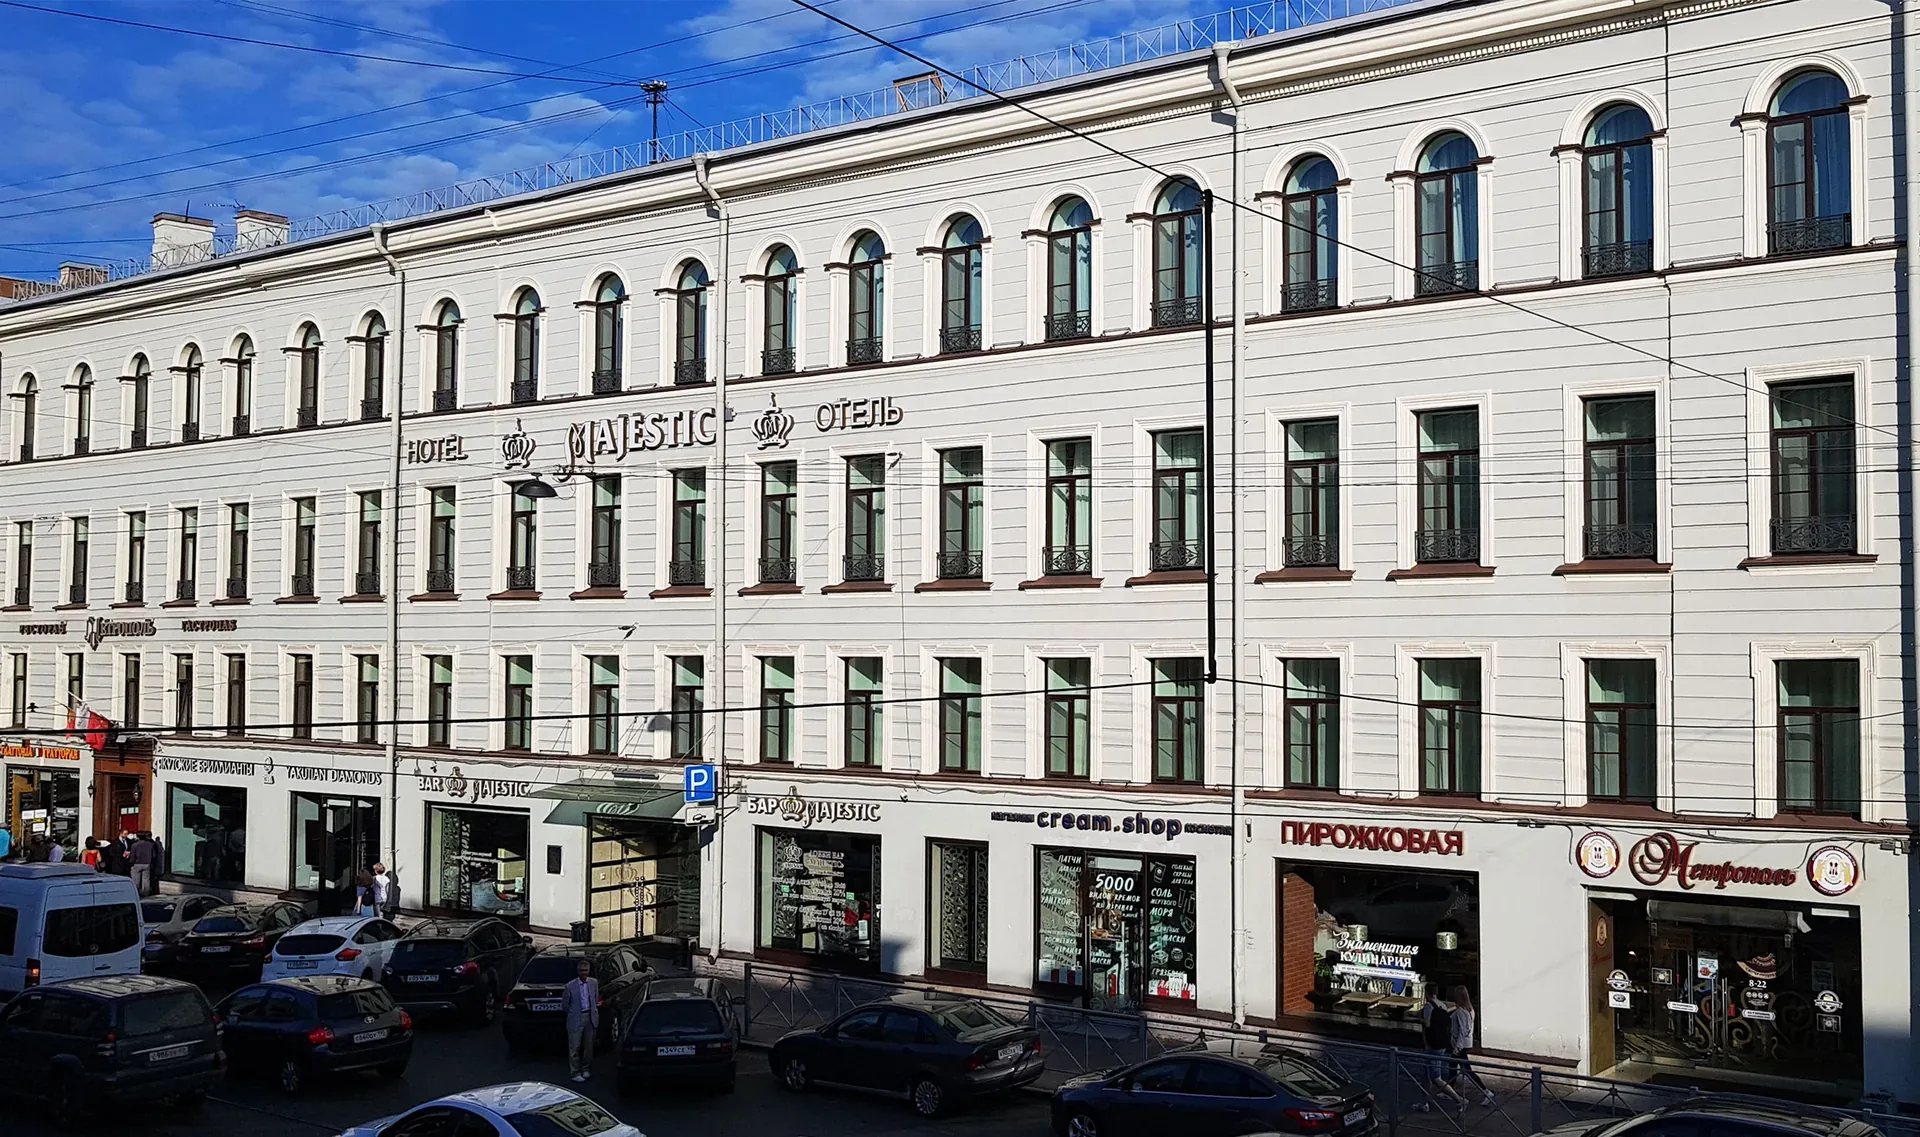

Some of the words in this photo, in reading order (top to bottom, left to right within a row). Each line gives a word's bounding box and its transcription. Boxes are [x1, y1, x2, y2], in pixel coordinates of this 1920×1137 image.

[815, 396, 904, 432] ОТЕЛЬ
[407, 435, 468, 464] HOTEL
[556, 407, 717, 482] MAJESTIC
[158, 757, 198, 773] ЯКУТСКИЕ
[199, 760, 255, 776] БРИЛЛИАНТЫ
[331, 768, 383, 785] DIAMONDS
[691, 769, 708, 798] P
[418, 776, 444, 792] BAR
[470, 779, 530, 803] MAJESTIC
[747, 796, 779, 814] БАР
[801, 801, 881, 828] MAJESTIC
[1036, 812, 1183, 841] cream.shop
[1281, 820, 1465, 855] ПИРОЖКОВАЯ
[1058, 854, 1081, 864] ПАТЧИ
[1628, 832, 1796, 890] Метрополь
[1095, 873, 1134, 892] 5000
[1114, 893, 1141, 903] КРЕМОВ
[1151, 888, 1173, 898] СОЛЬ
[1150, 906, 1174, 918] МОРЯ
[1162, 934, 1186, 943] МАСКИ
[1332, 930, 1420, 955] Знаменитая
[1340, 950, 1412, 968] КУЛИНАРИЯ
[1748, 979, 1767, 989] 8-22
